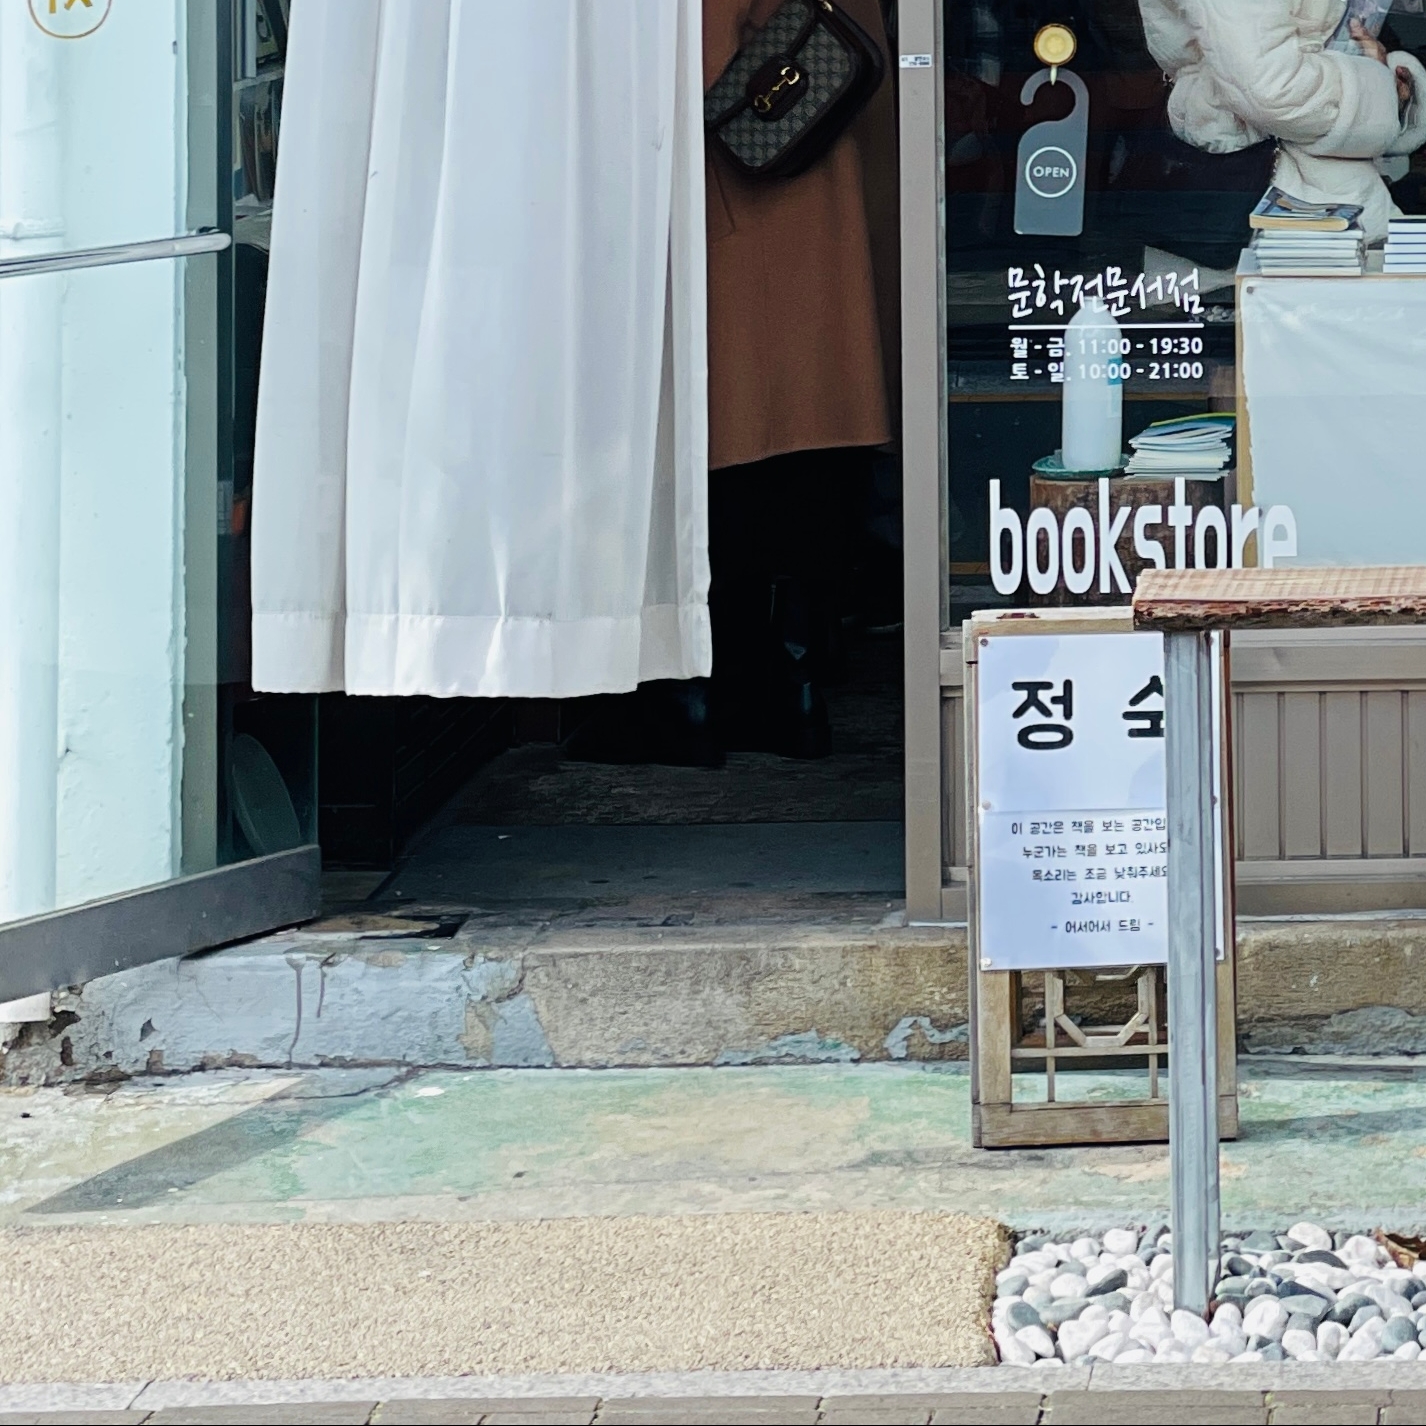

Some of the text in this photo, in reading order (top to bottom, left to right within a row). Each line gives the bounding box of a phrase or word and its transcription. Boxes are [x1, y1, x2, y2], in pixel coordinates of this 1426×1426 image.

[1032, 165, 1070, 178] OPEN
[1007, 263, 1205, 319] 문학전문서점
[1078, 337, 1132, 355] 11:00
[1148, 337, 1204, 355] 19:30
[1009, 362, 1030, 380] 토
[1078, 362, 1132, 380] 10:00
[1148, 362, 1204, 380] 21:00
[988, 476, 1299, 596] bookstore
[1011, 817, 1166, 835] 이 공간은 책을 보는 공간입
[1022, 841, 1168, 859] 누군가는 책을 보고 있사오
[1032, 868, 1077, 882] 목소리는
[1084, 867, 1107, 880] 조금
[1065, 920, 1112, 934] 어서어서
[1118, 918, 1142, 932] 드림
